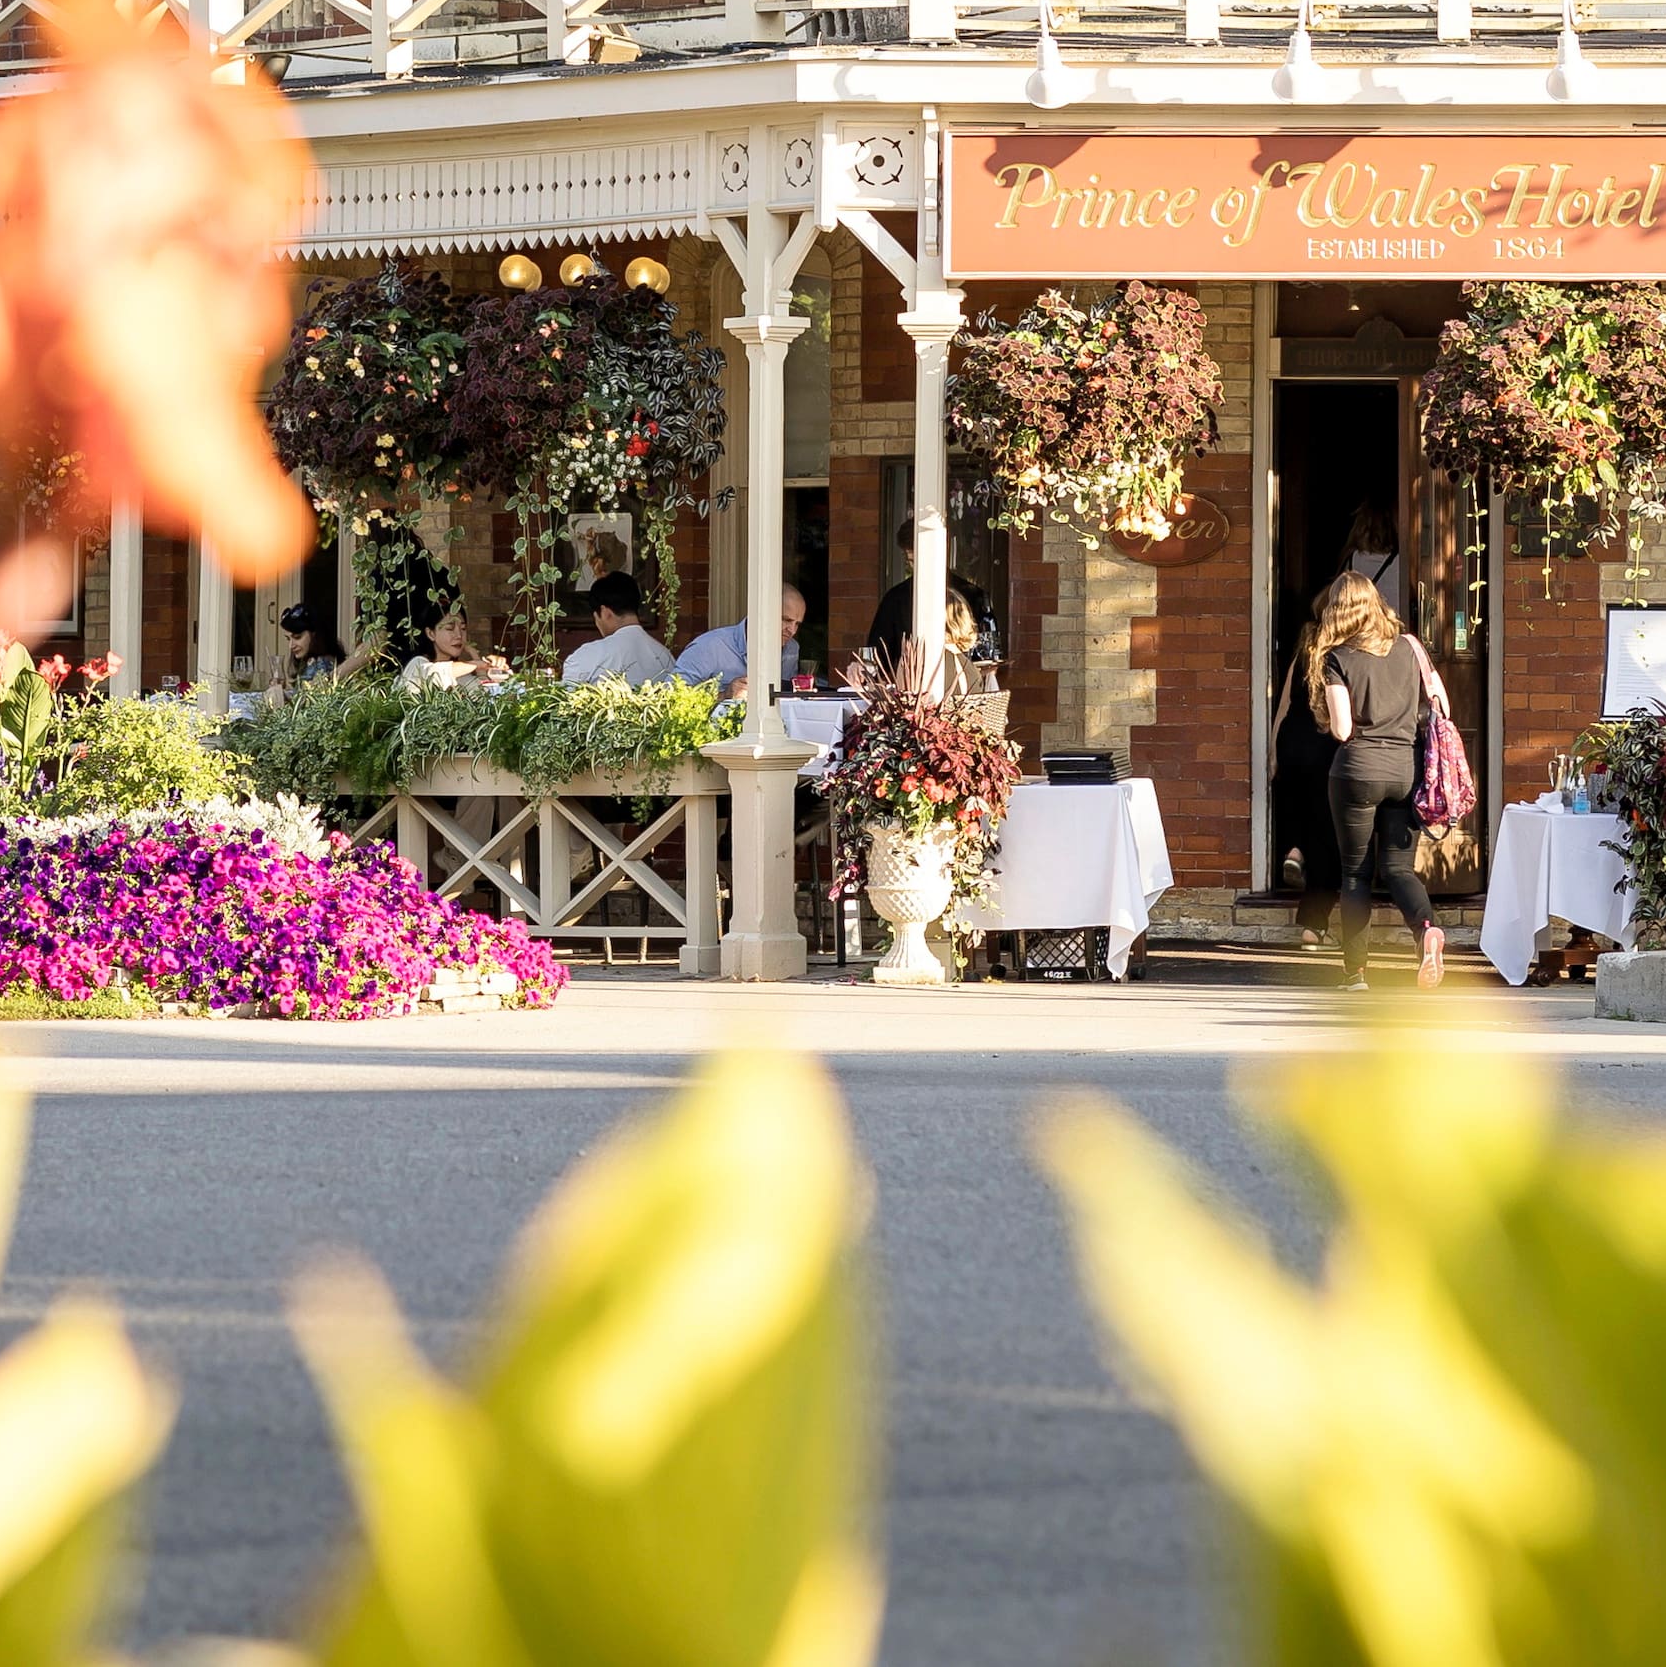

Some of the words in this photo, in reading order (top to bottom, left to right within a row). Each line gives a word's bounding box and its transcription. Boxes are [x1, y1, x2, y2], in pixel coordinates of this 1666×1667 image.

[994, 162, 1200, 229] Prince
[1210, 160, 1290, 247] of
[1286, 161, 1488, 237] Wales
[1490, 162, 1666, 229] Hotel
[1307, 237, 1446, 261] ESTABLISHED
[1492, 236, 1565, 260] 1864
